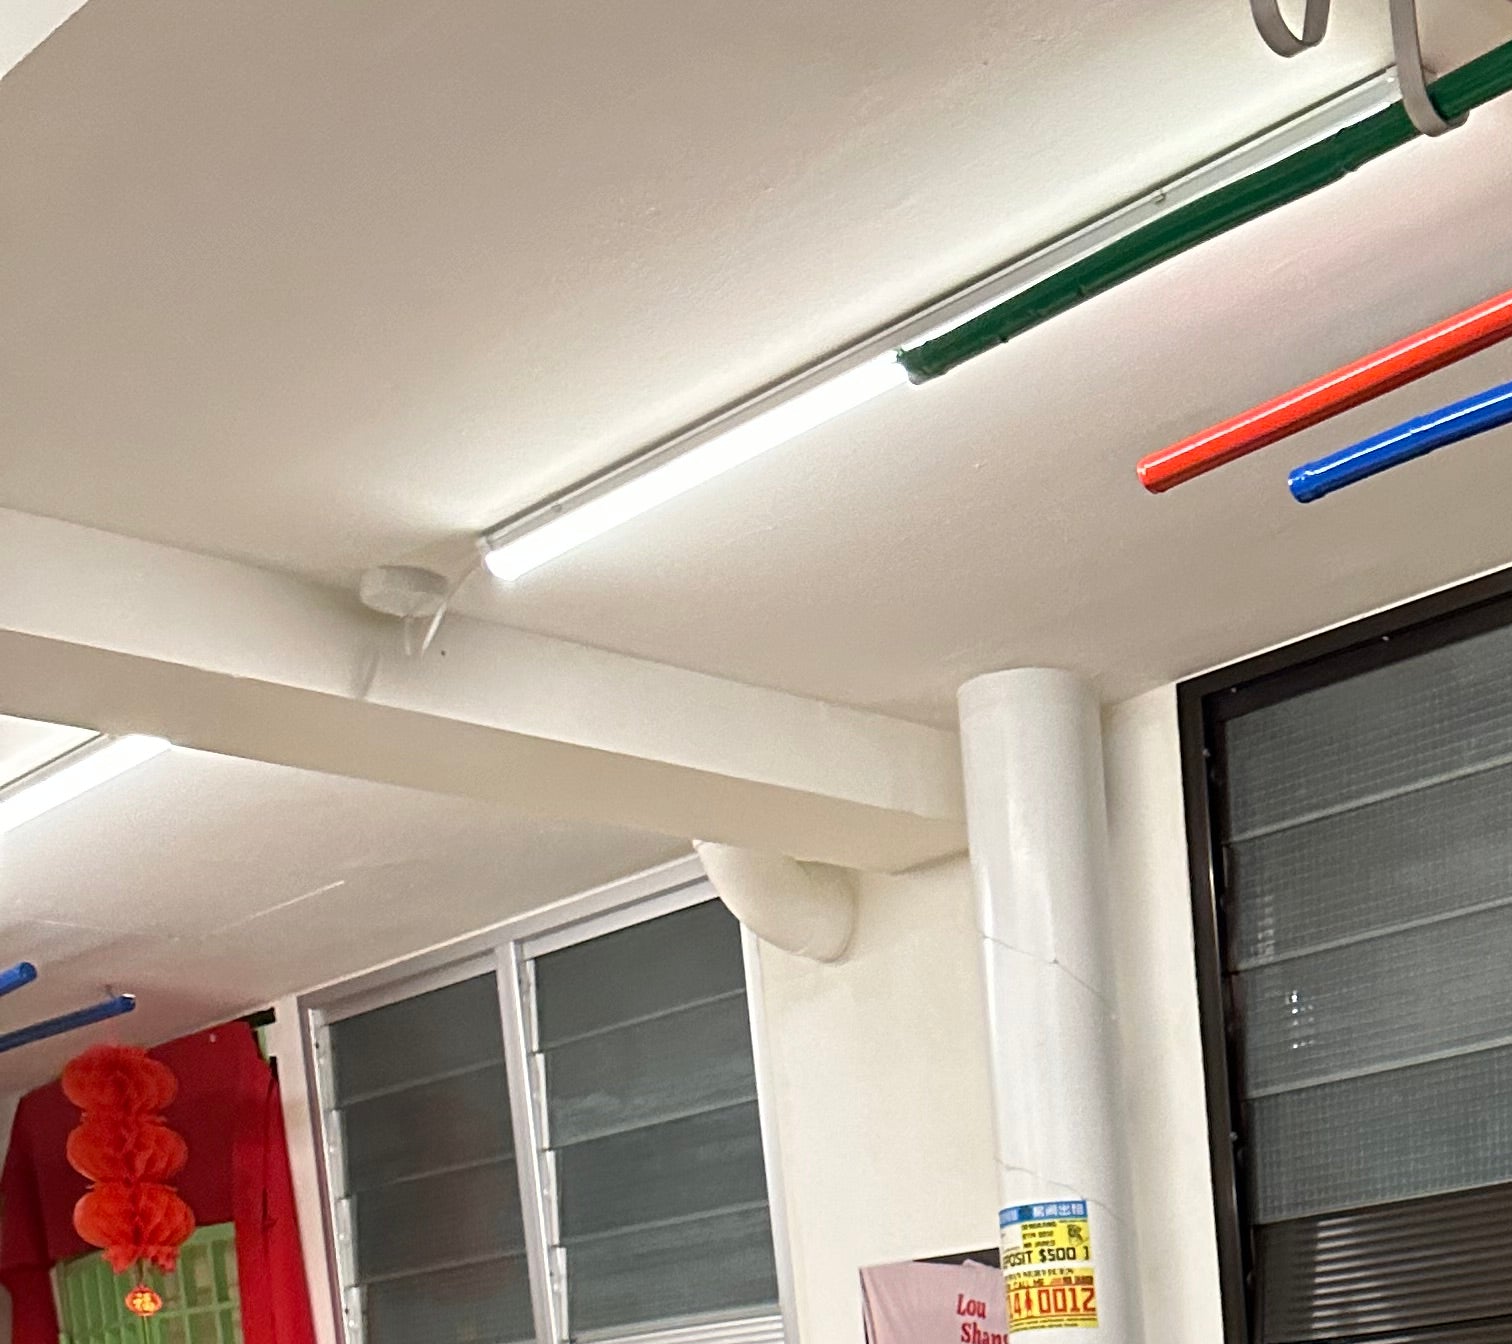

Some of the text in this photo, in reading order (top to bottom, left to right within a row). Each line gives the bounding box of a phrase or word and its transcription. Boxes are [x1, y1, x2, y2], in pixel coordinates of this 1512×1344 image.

[1039, 1247, 1076, 1262] $500
[957, 1294, 986, 1319] Lou
[1038, 1287, 1096, 1314] 0012
